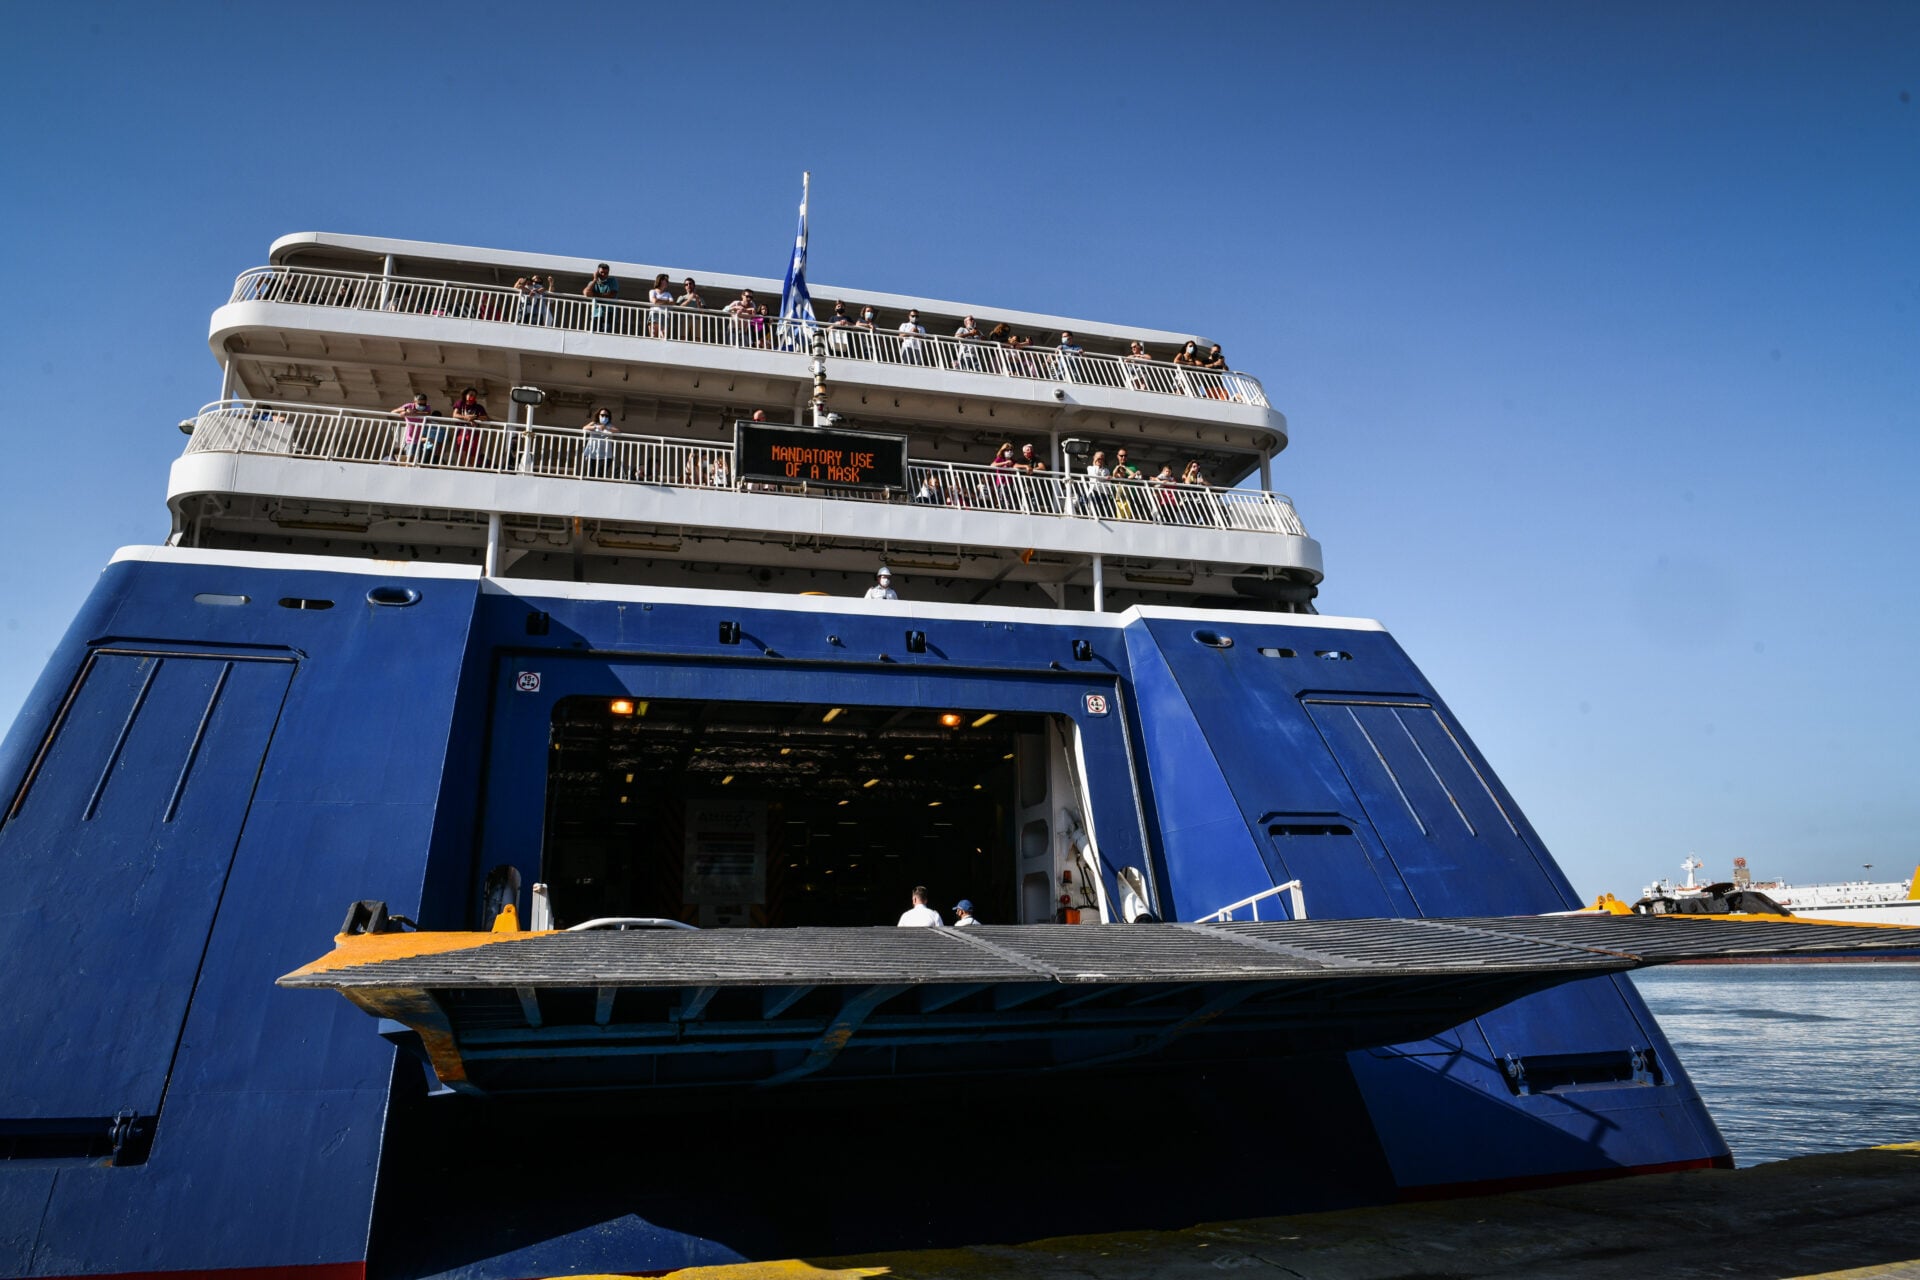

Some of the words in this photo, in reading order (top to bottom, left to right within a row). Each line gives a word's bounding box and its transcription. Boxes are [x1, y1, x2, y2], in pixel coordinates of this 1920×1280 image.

[771, 445, 843, 466] MANDATORY
[850, 452, 875, 468] USE
[785, 461, 802, 477] OF
[810, 464, 820, 479] A
[827, 465, 860, 482] MASK
